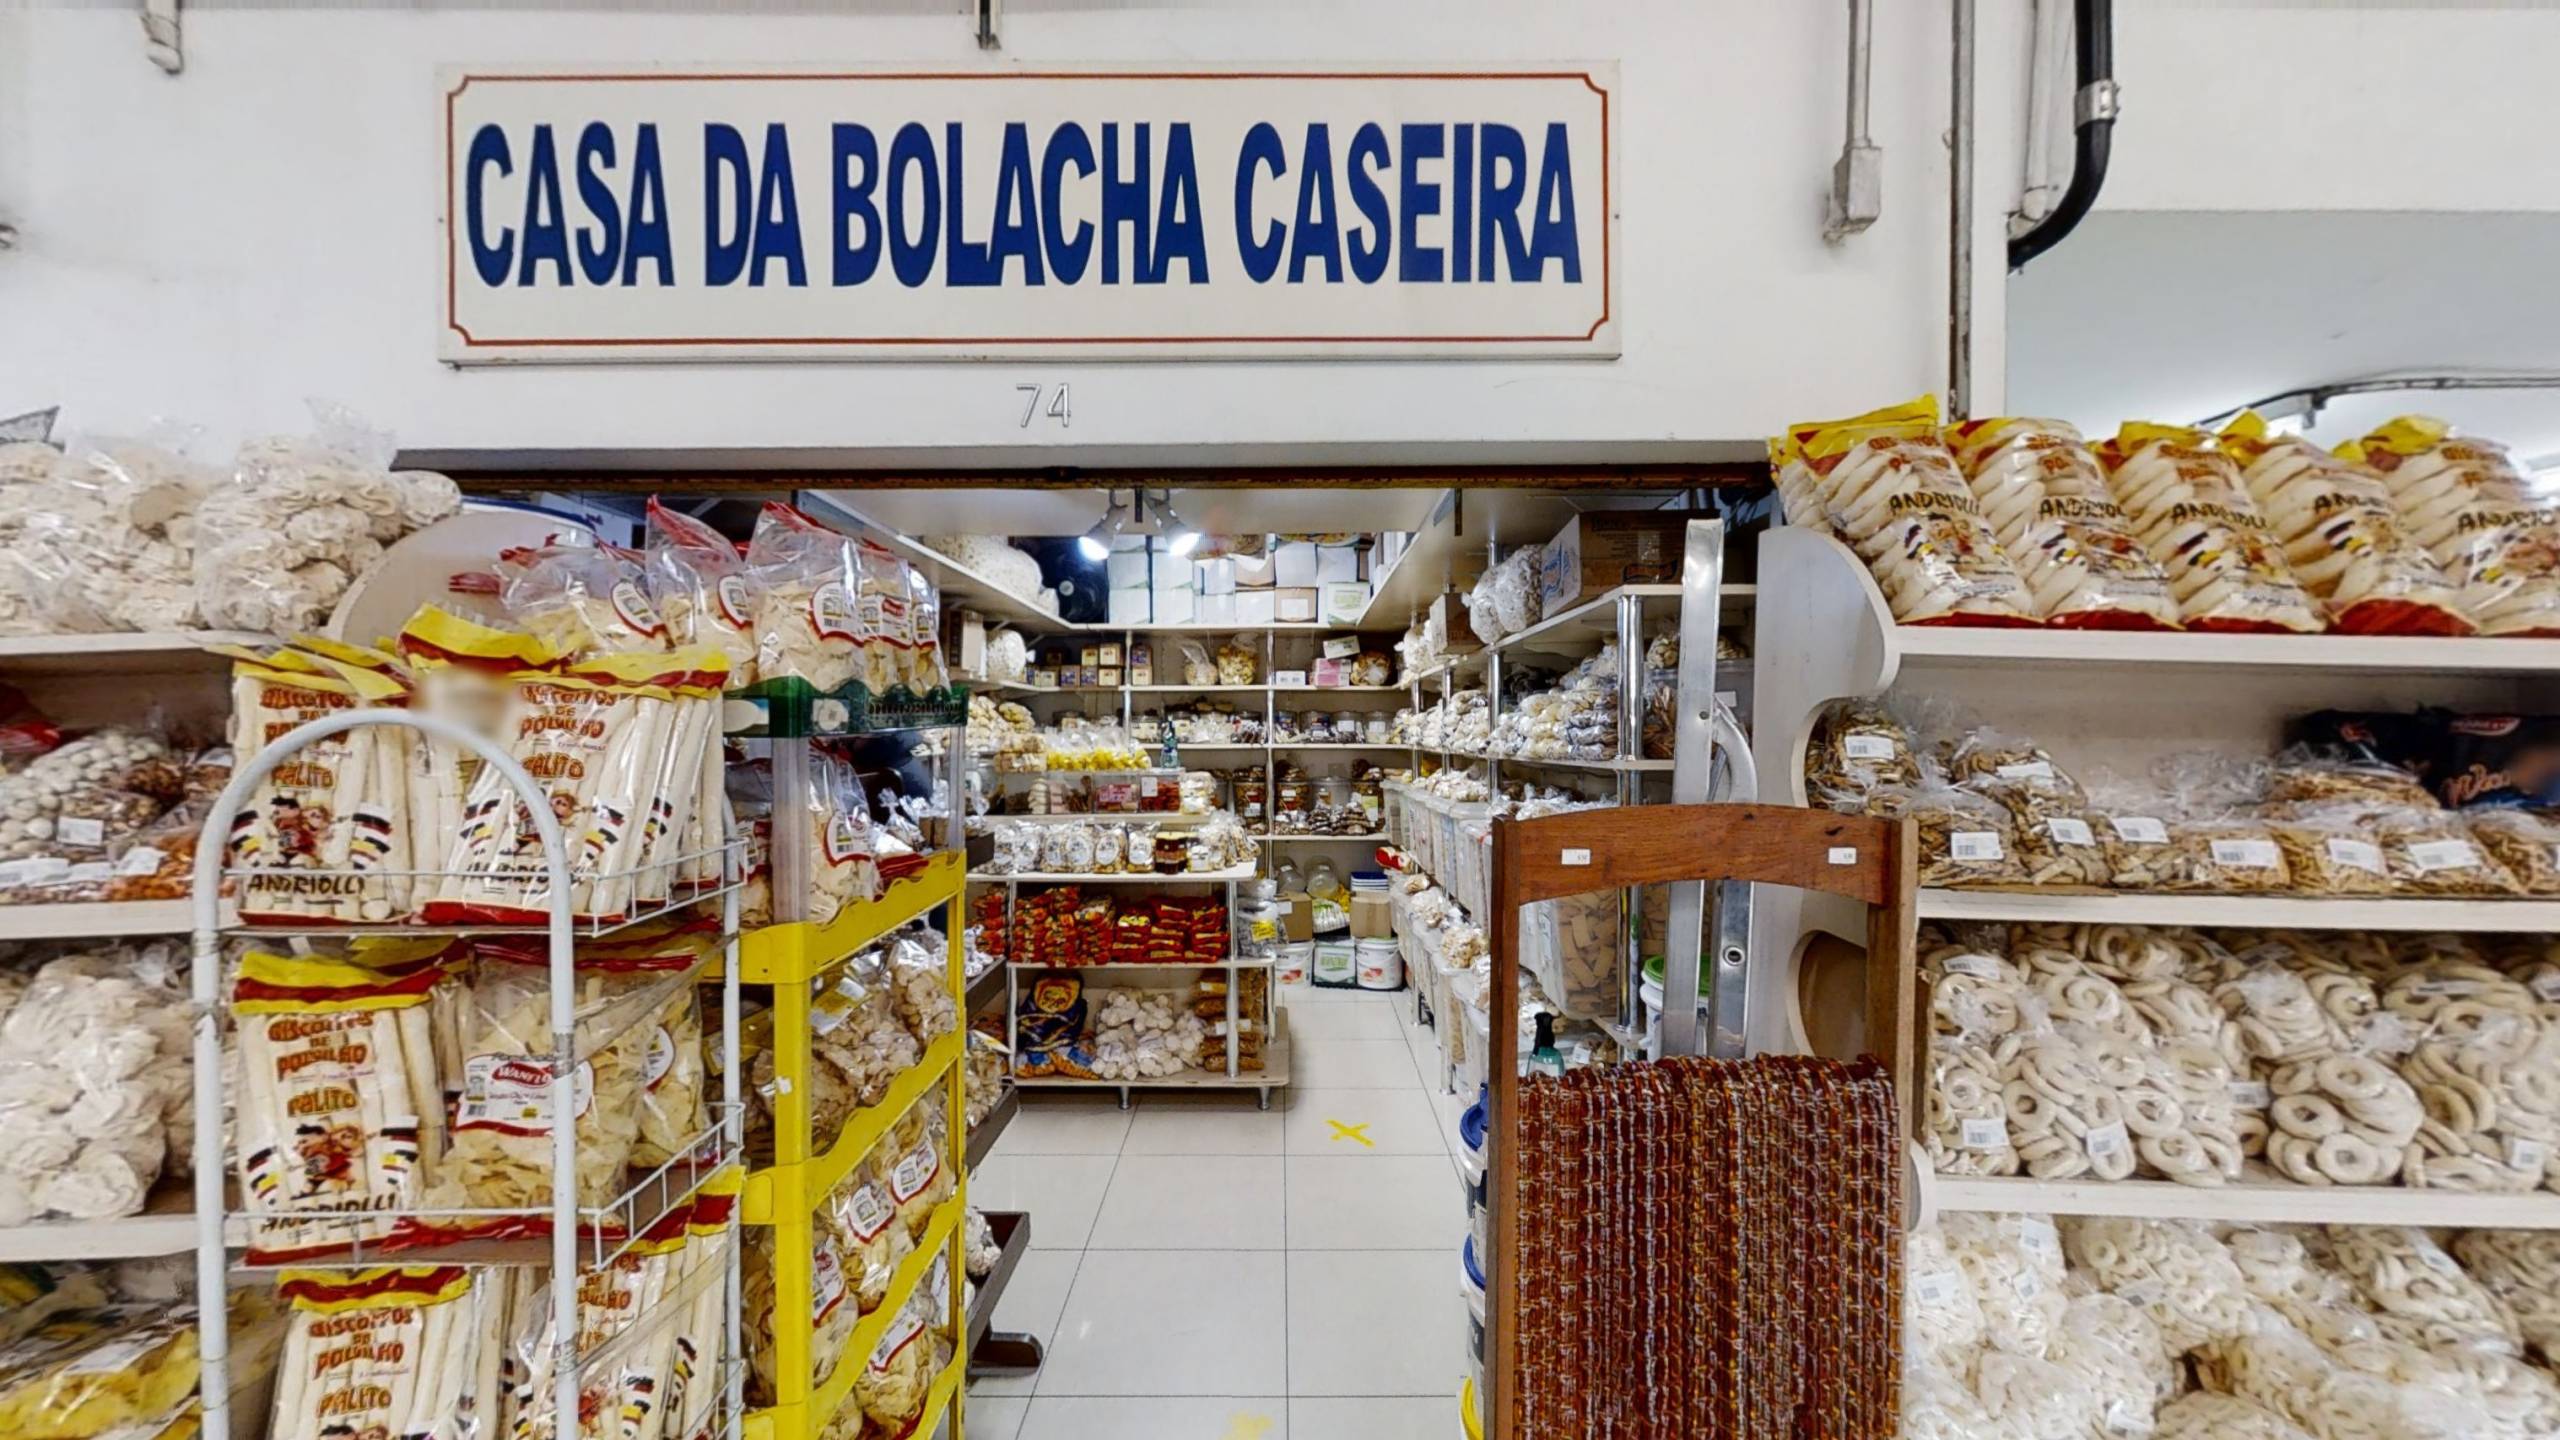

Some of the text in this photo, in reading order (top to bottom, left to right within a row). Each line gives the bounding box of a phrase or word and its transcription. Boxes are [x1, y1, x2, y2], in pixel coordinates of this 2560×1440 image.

[466, 120, 1583, 288] CASA DA BOLACHA CASEIRA
[1016, 383, 1071, 428] 74
[315, 1384, 392, 1418] PALITO
